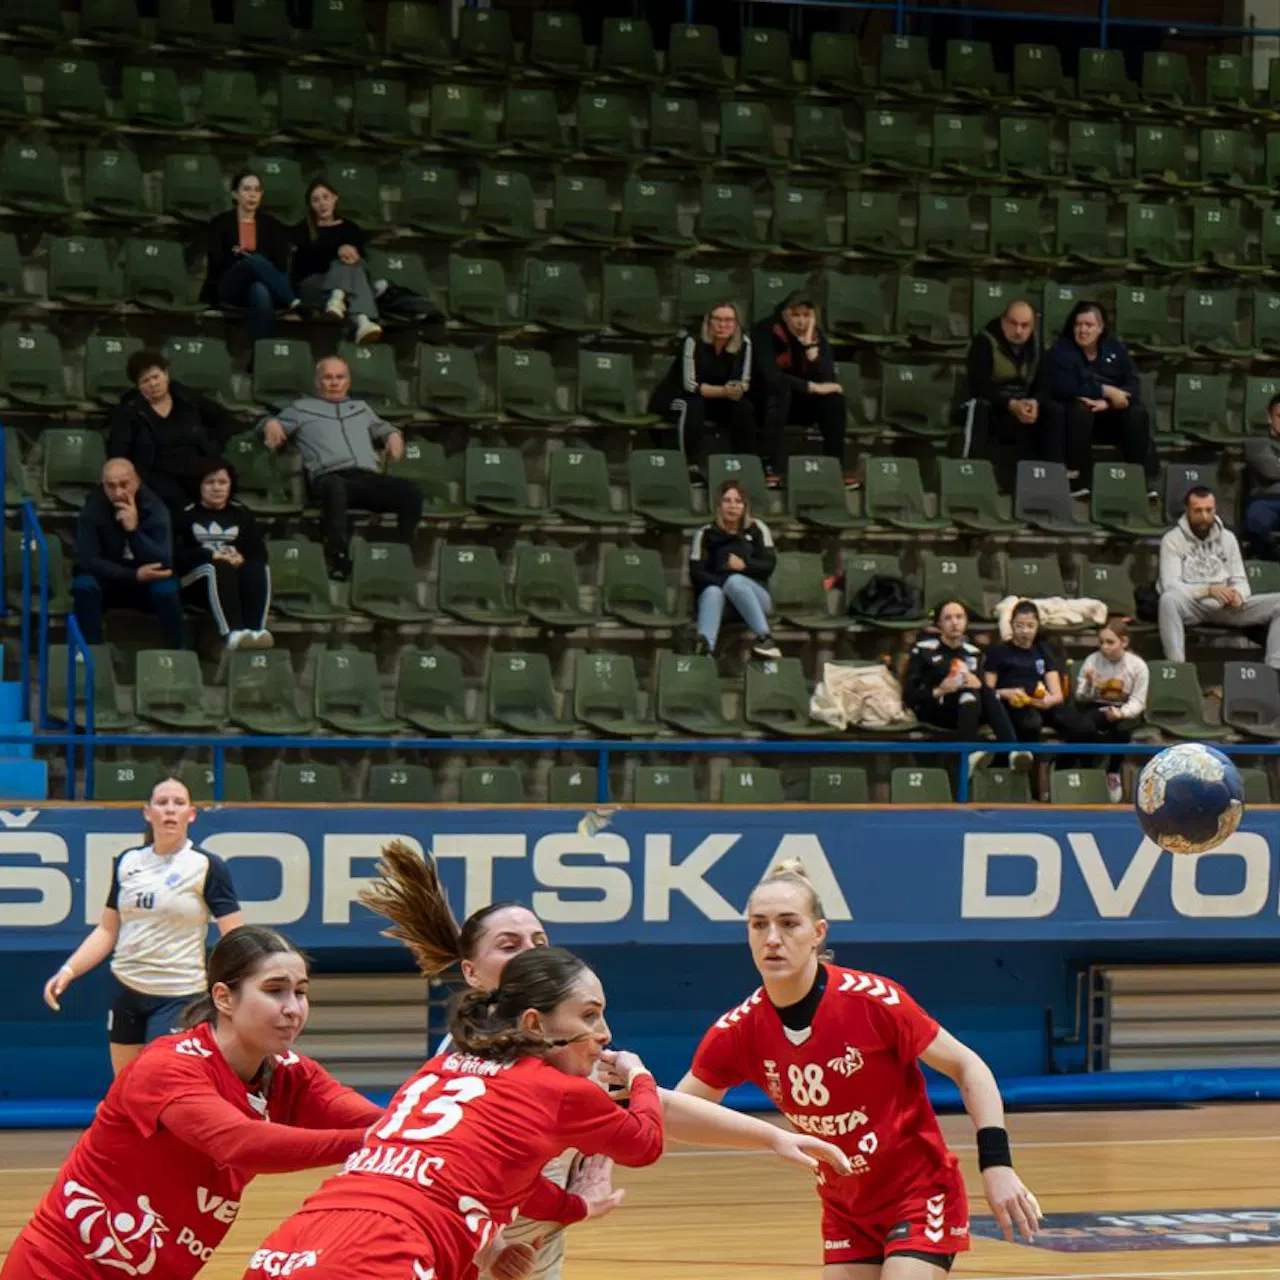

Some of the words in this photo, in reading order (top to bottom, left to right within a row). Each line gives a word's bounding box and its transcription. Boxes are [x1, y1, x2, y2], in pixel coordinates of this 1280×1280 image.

[941, 561, 958, 574] 23
[376, 1072, 487, 1140] 13
[787, 1062, 830, 1107] 88
